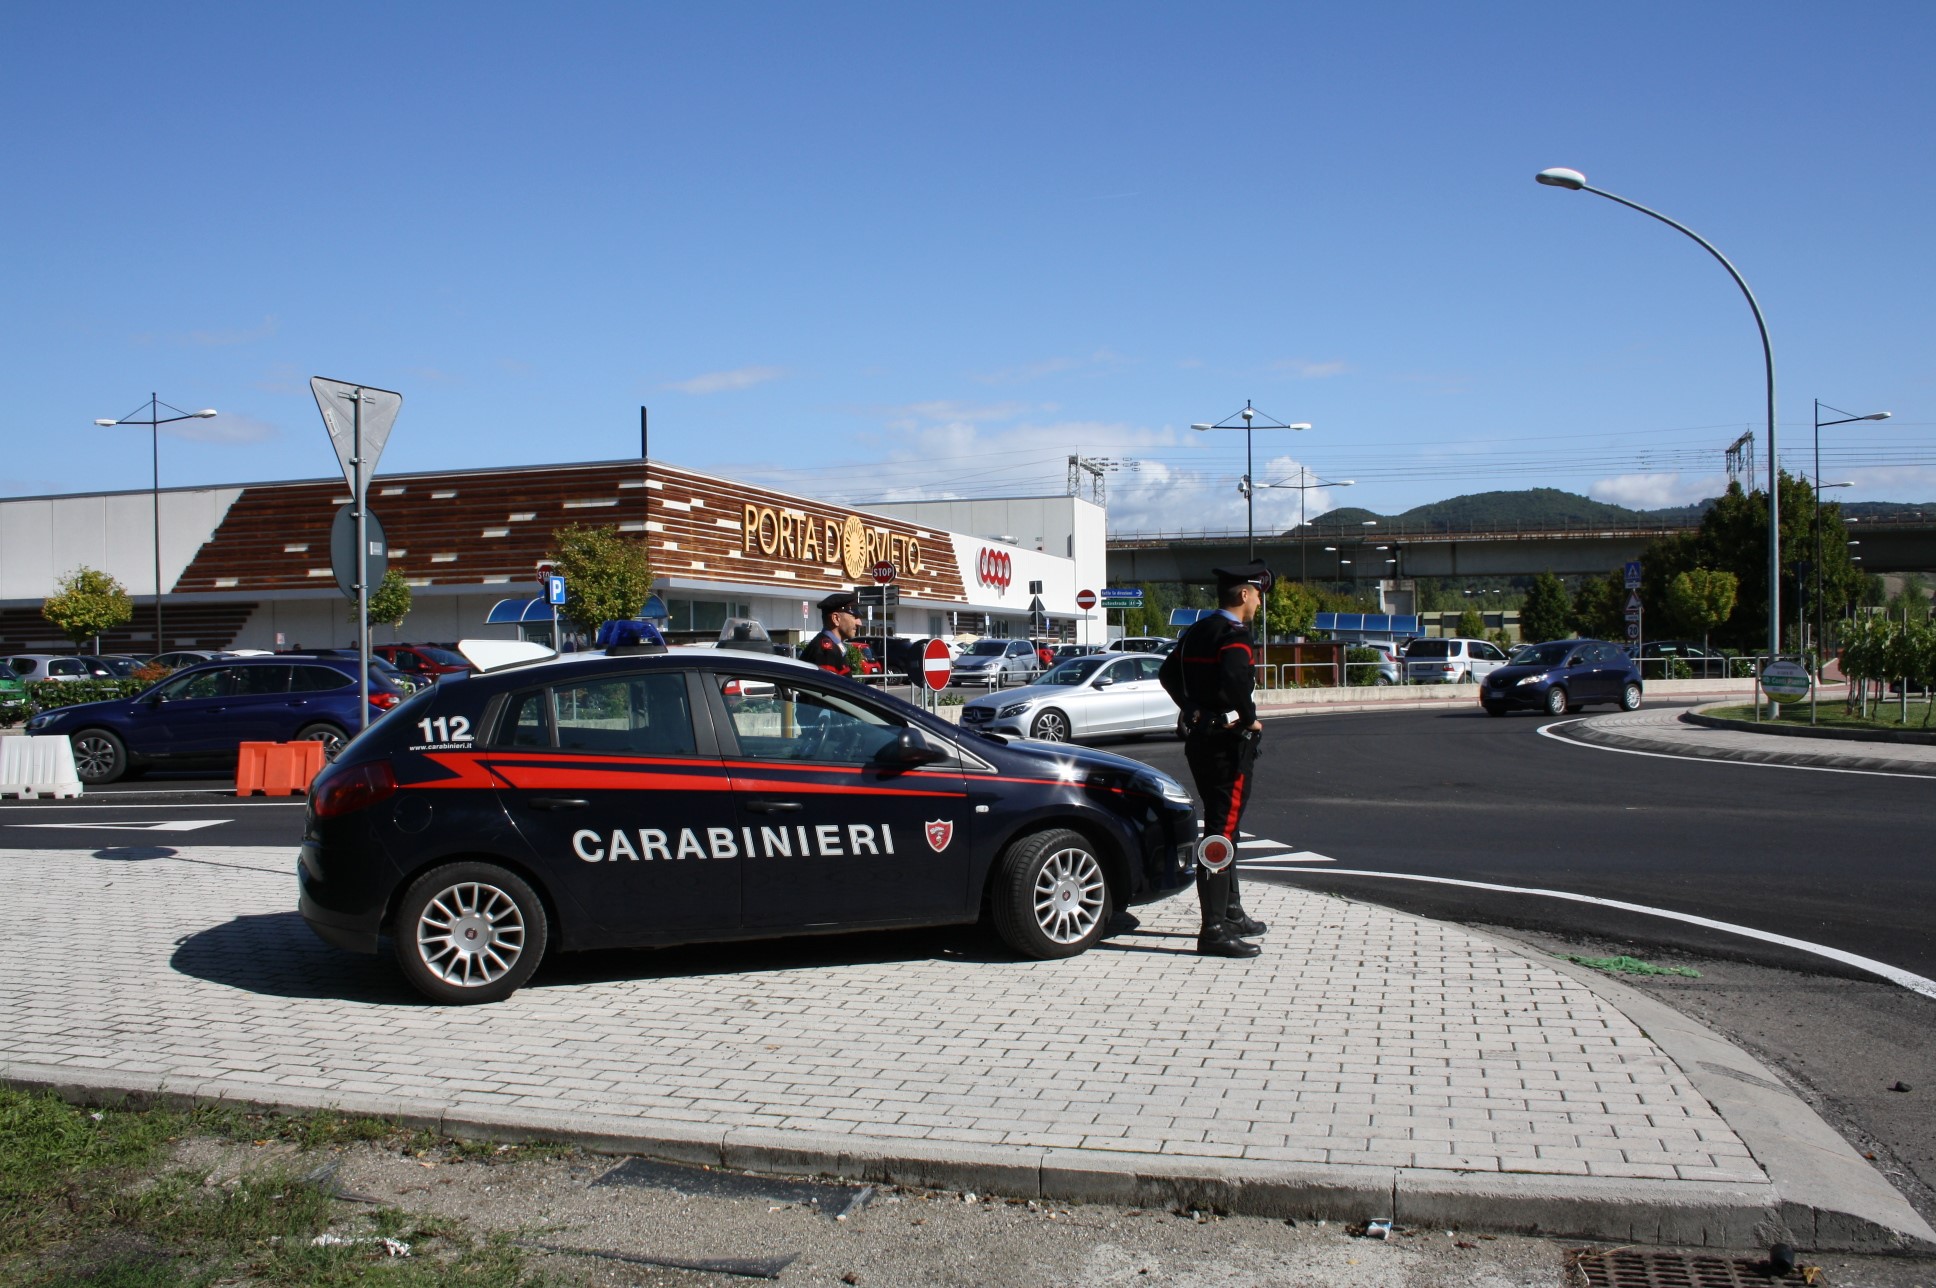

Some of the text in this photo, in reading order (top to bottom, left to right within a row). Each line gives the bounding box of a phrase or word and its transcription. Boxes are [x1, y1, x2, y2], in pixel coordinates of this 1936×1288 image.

[744, 503, 820, 562] PORTA
[873, 567, 892, 577] STOP
[979, 546, 1012, 597] coop
[552, 579, 562, 601] P
[1629, 626, 1638, 636] 20
[417, 715, 473, 743] 112
[409, 742, 472, 751] www.carabinieri.it
[572, 823, 895, 863] CARABINIERI
